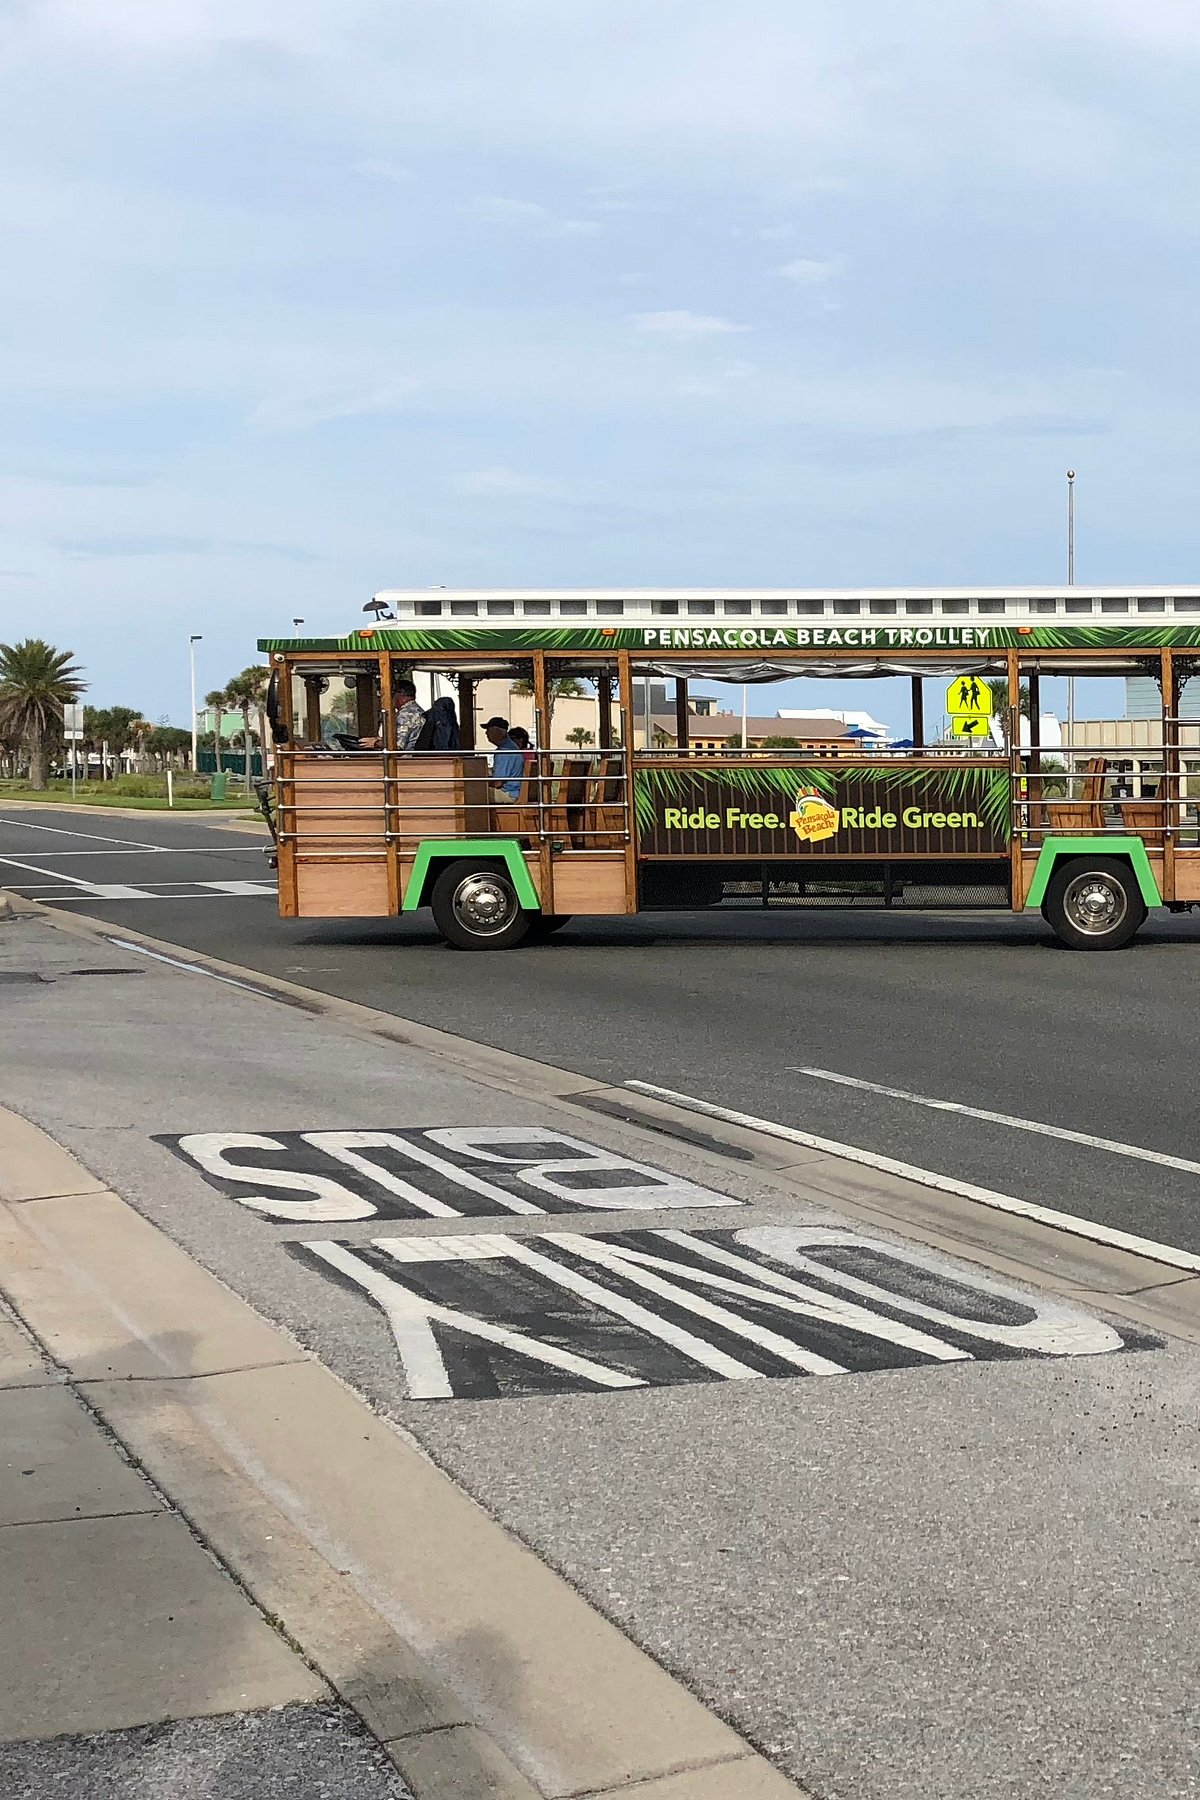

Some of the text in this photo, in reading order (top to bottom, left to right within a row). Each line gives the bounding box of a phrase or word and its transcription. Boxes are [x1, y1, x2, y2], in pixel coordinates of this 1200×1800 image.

[644, 629, 991, 646] PENSACOLA BEACH TROLLEY
[665, 807, 786, 829] Ride Free.
[795, 810, 835, 828] Pensacola
[802, 820, 835, 835] Beach
[842, 807, 984, 829] Ride Green.
[176, 1126, 748, 1221] BUS
[302, 1225, 1125, 1398] ONLY
